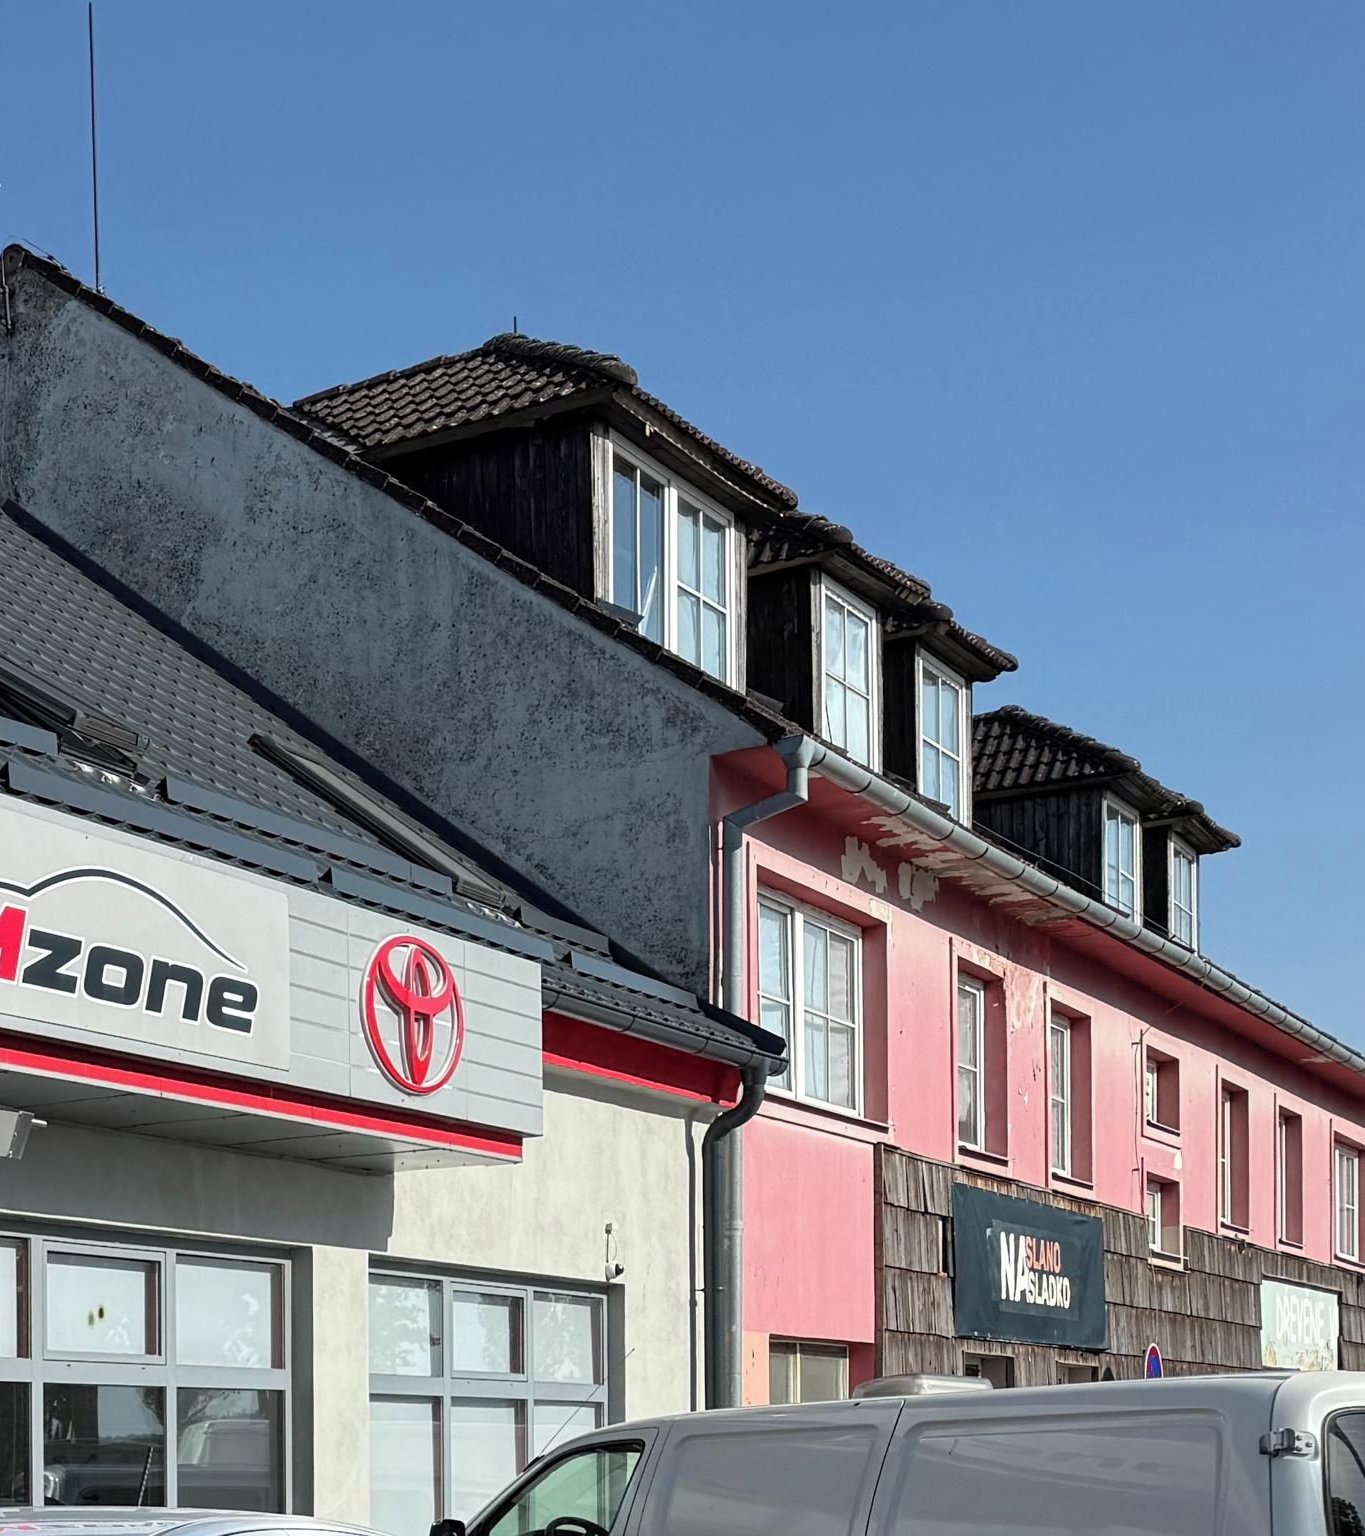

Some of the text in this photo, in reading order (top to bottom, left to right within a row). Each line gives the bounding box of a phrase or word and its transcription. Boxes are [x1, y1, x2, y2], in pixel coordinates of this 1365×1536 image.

[1000, 1231, 1061, 1303] NA SLANO
[1029, 1271, 1071, 1309] SLADKO
